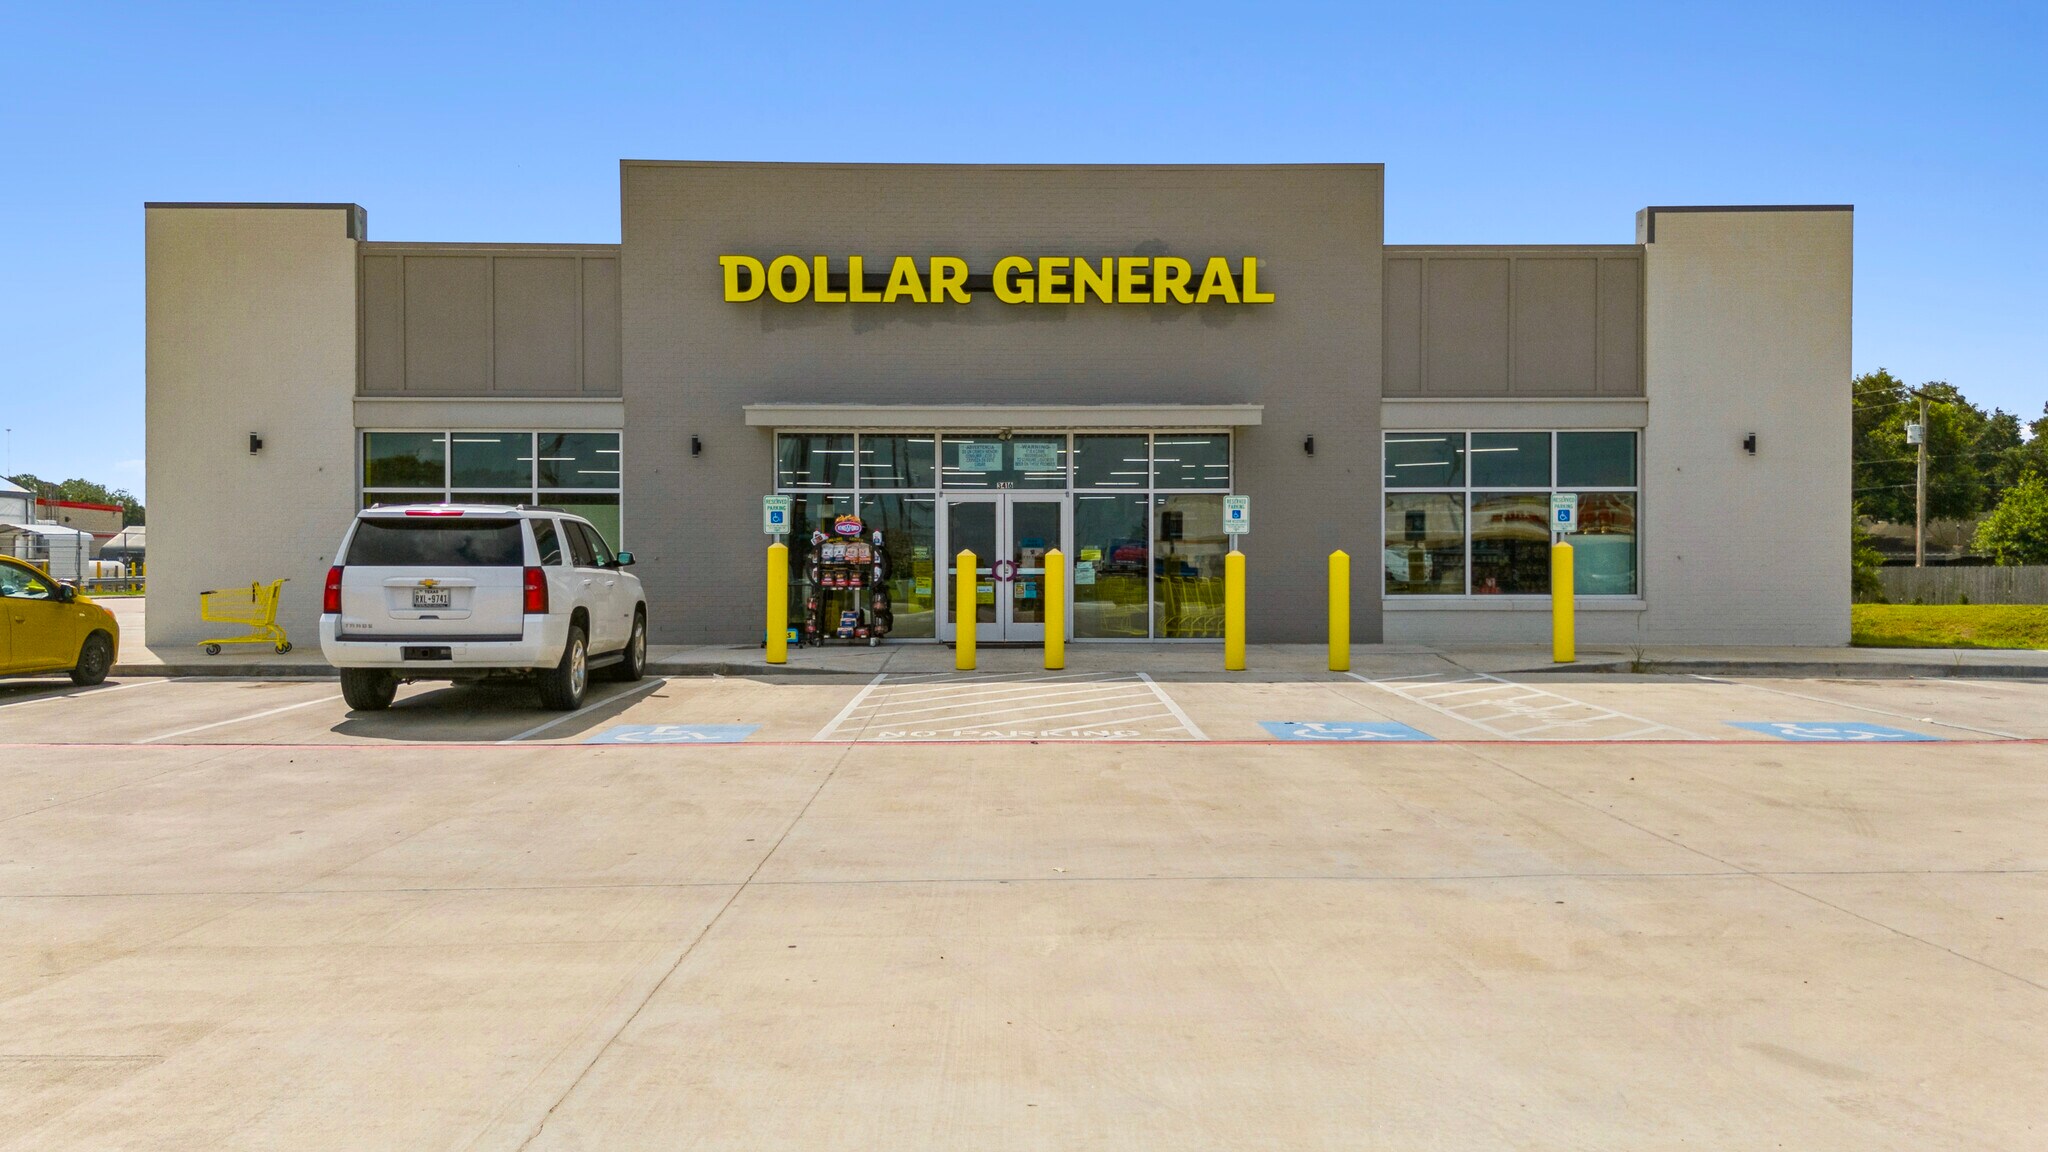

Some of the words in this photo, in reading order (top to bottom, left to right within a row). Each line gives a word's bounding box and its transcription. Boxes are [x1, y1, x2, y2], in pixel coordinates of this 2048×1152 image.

[719, 255, 972, 304] DOLLAR
[992, 256, 1276, 304] GENERAL
[878, 730, 937, 738] NO
[953, 729, 1142, 738] PARKING
